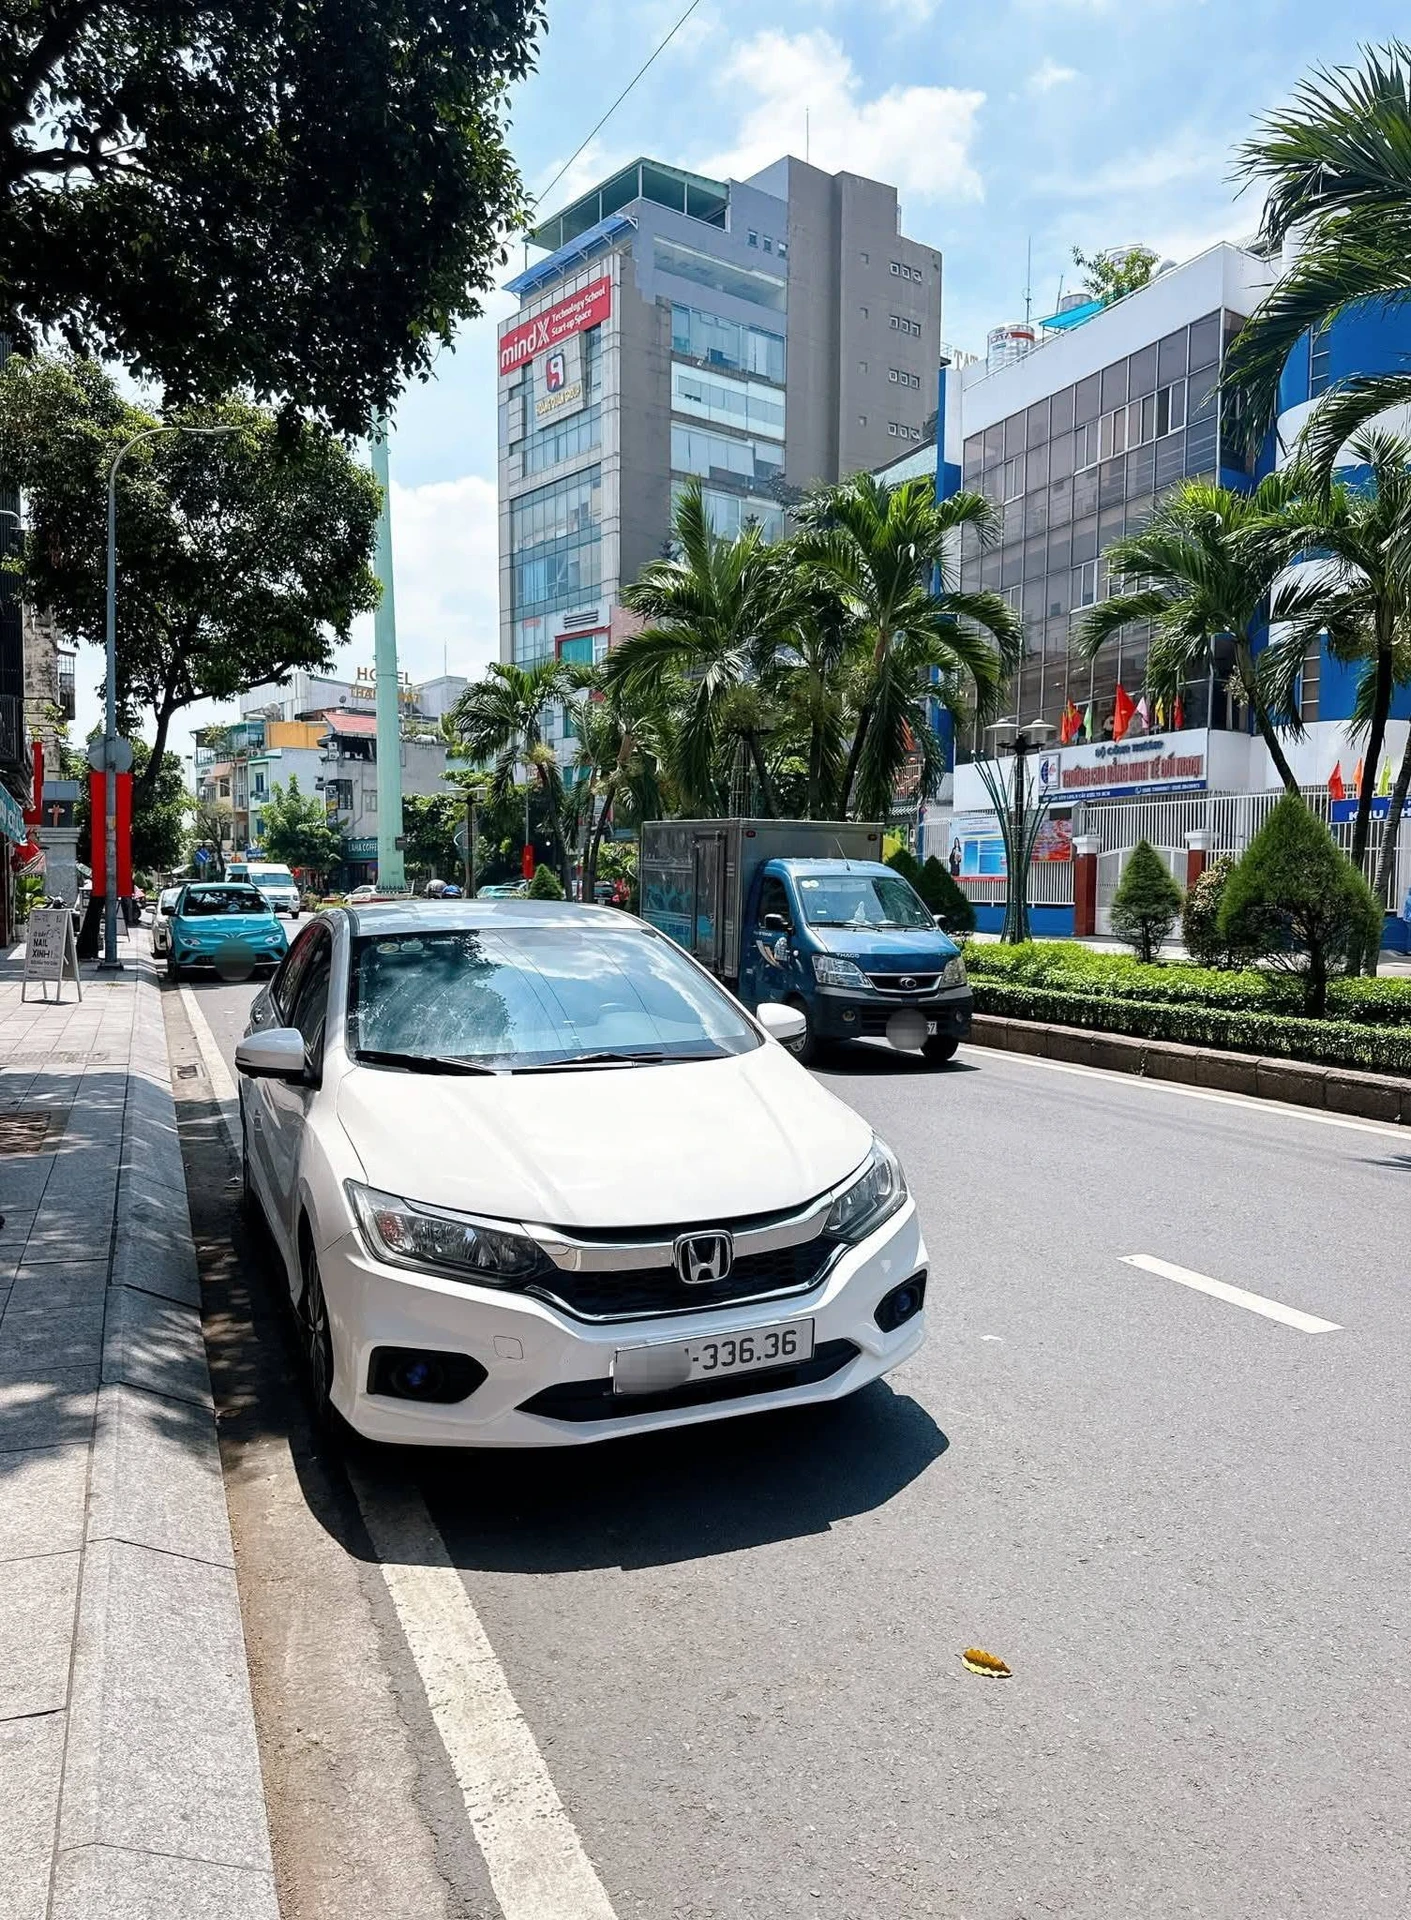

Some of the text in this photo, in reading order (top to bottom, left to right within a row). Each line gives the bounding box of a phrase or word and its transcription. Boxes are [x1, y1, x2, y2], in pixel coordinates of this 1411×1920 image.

[552, 286, 606, 323] Technology School
[575, 308, 593, 324] Space
[501, 316, 550, 369] mindX
[357, 667, 412, 686] HOEL
[1348, 809, 1384, 821] KU
[33, 938, 48, 947] NAIL
[685, 1329, 797, 1371] -336.36
